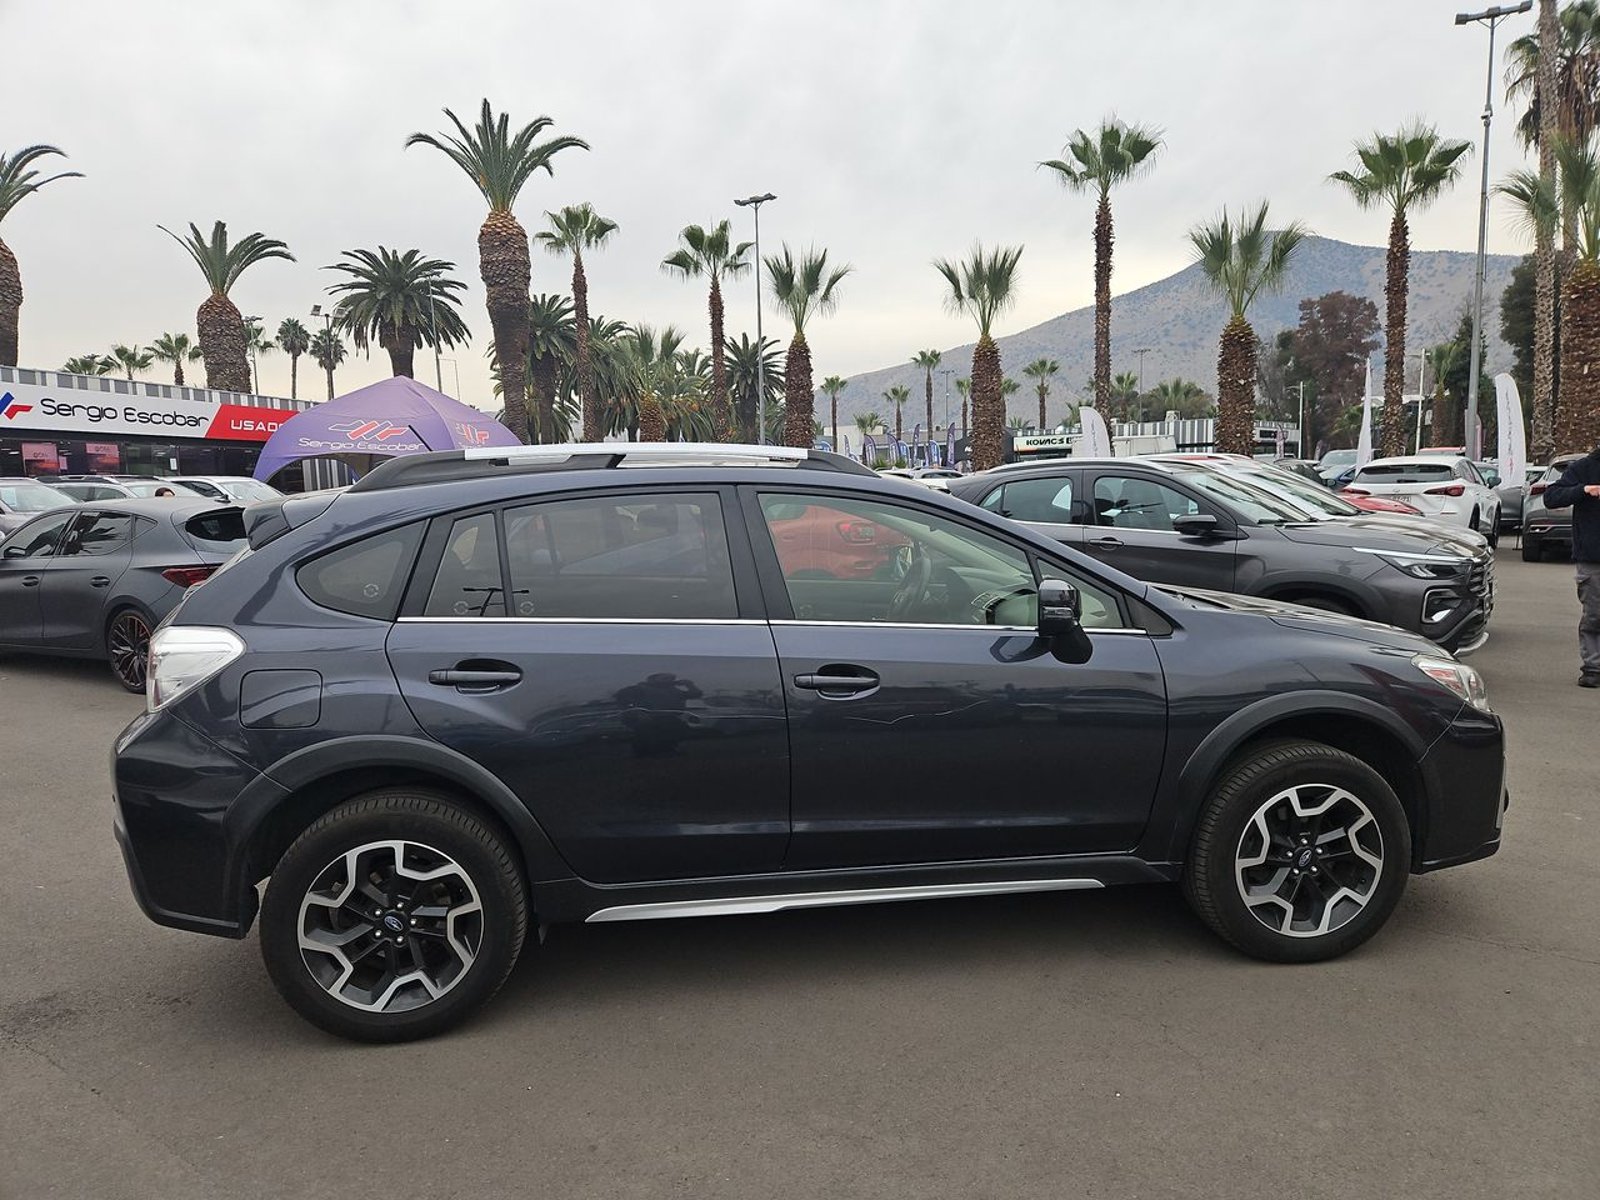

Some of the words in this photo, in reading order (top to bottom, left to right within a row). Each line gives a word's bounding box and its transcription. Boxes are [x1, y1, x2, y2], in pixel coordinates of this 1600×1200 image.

[40, 398, 118, 422] Sergio
[124, 407, 209, 426] Escobar
[230, 419, 284, 432] USAD
[357, 441, 424, 451] Escobar
[1026, 437, 1064, 446] KOVACS
